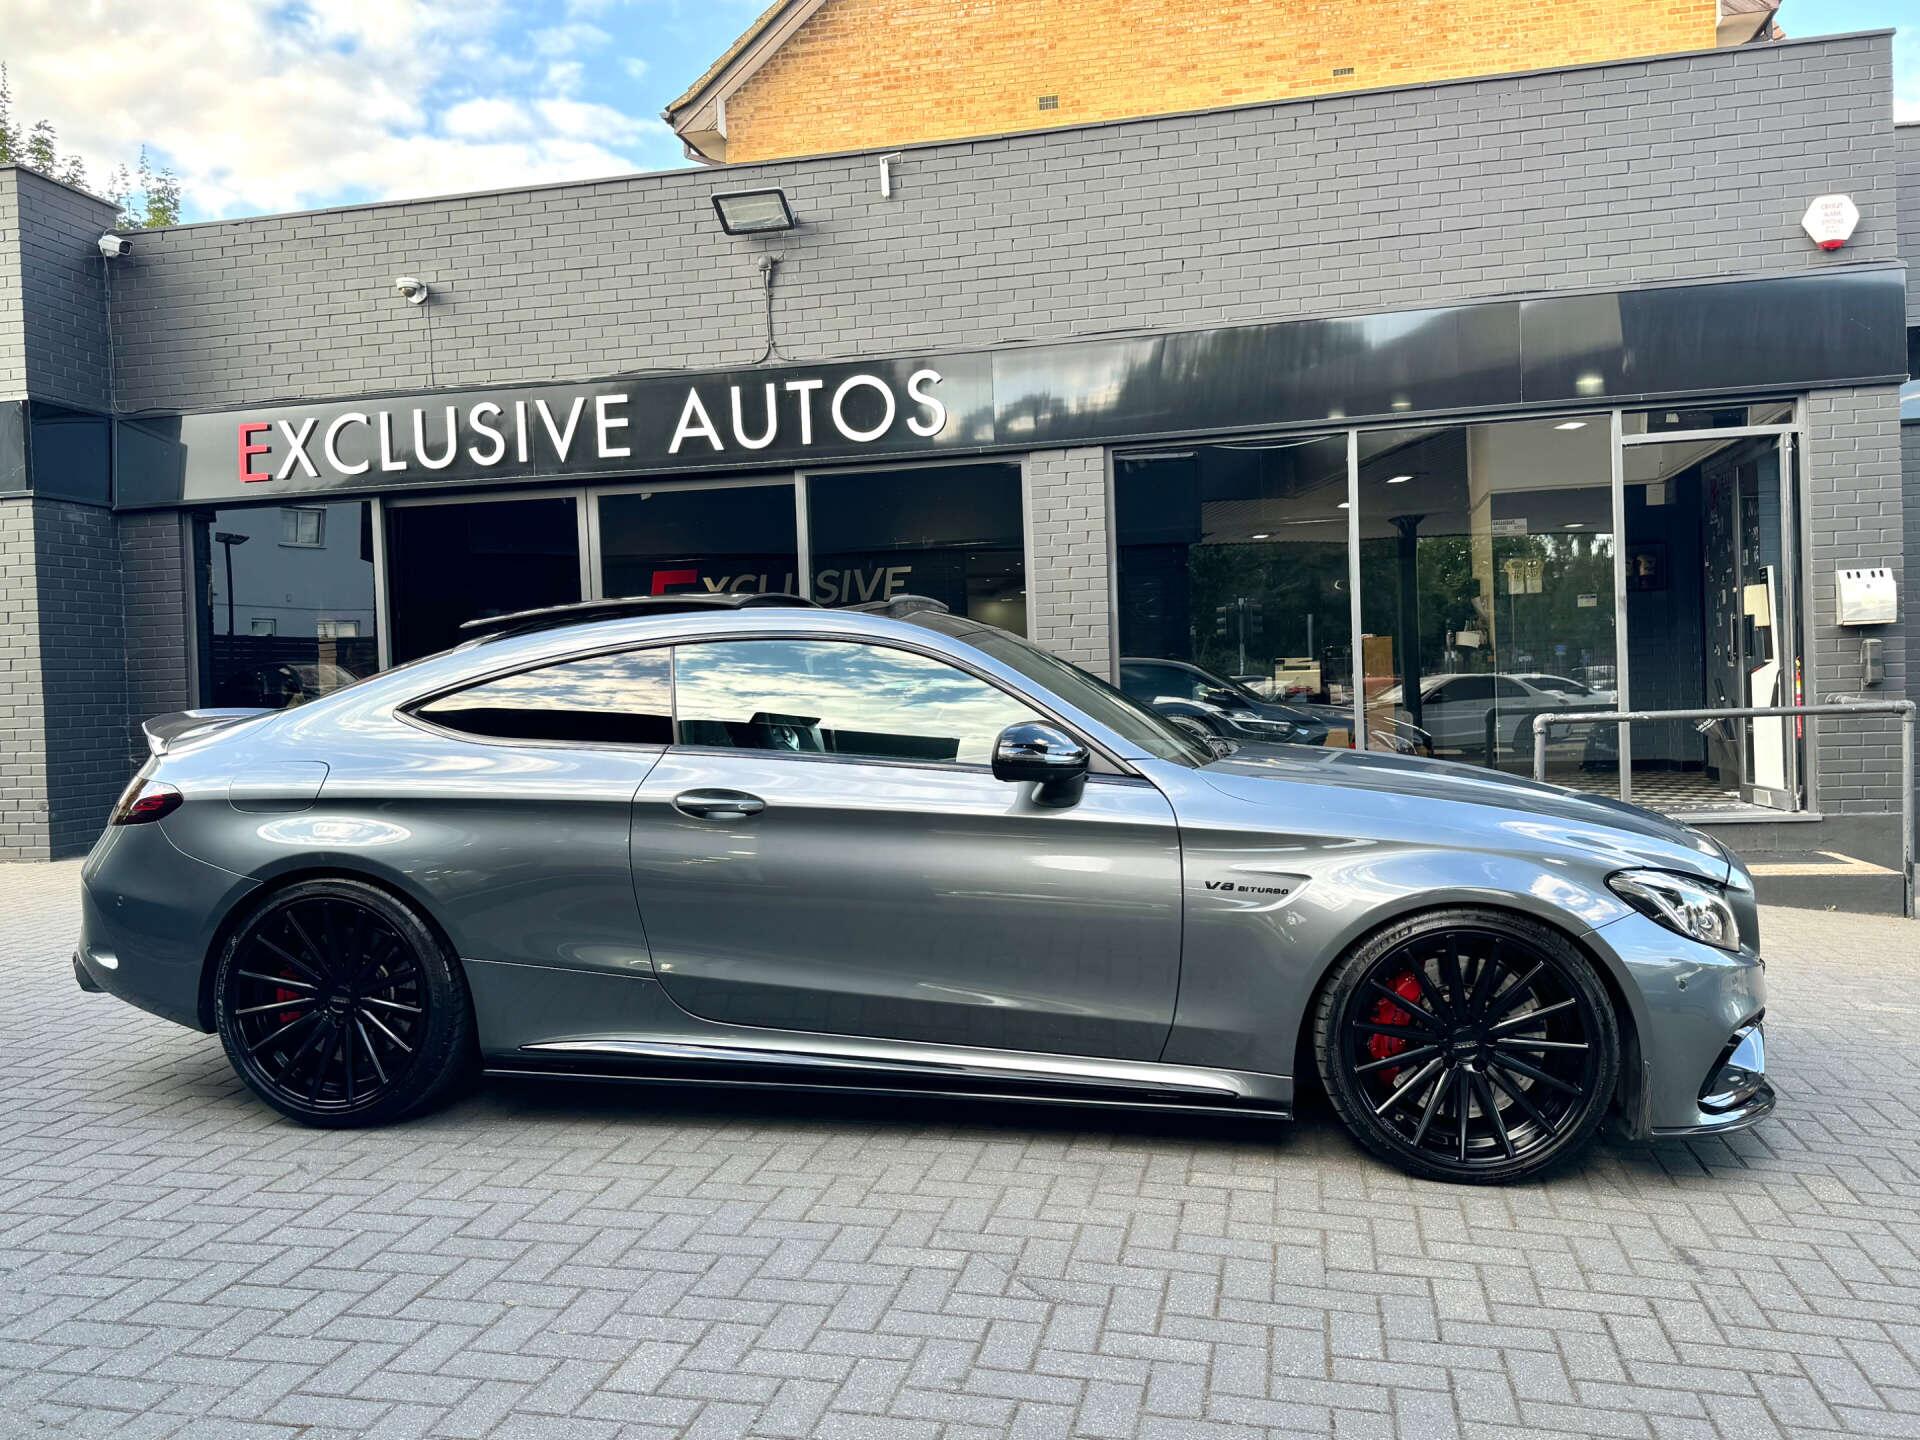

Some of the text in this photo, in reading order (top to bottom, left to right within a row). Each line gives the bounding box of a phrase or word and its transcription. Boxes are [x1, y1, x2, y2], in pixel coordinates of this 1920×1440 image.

[237, 369, 947, 483] EXCLUSIVE AUTOS
[651, 566, 912, 605] EXCSIVE
[1204, 880, 1289, 895] V8 BITURBO
